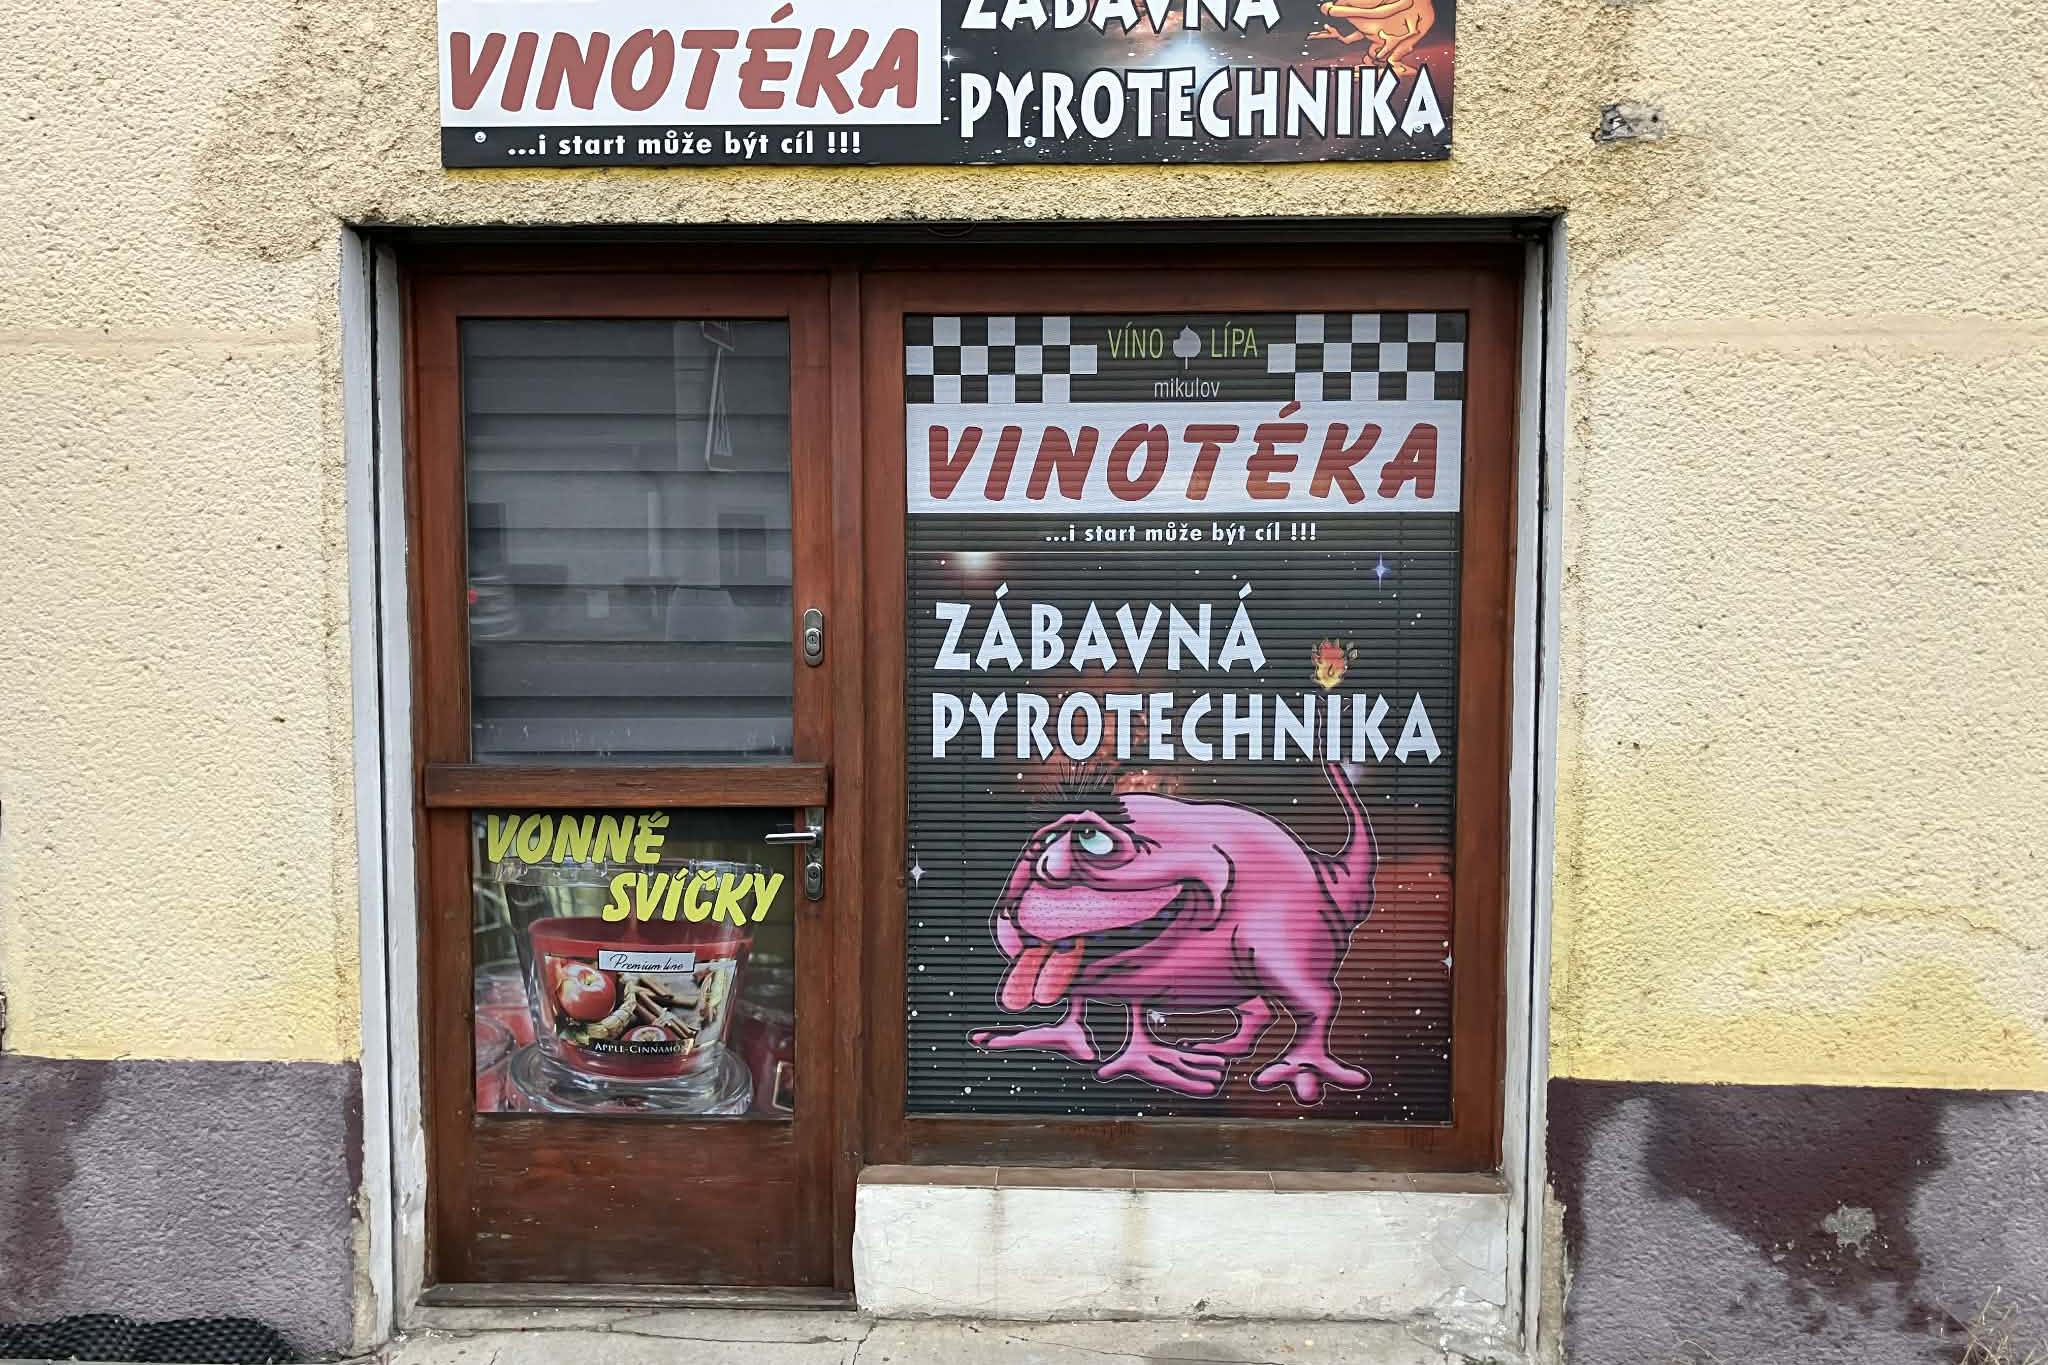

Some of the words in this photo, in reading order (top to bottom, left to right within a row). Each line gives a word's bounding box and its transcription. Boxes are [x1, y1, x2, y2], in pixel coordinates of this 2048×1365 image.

[449, 2, 919, 114] VINOTÉKA
[960, 64, 1446, 139] PYROTECHNIKA
[508, 134, 546, 155] ...i
[558, 135, 625, 155] start
[638, 131, 712, 155] může
[725, 131, 768, 159] být
[781, 130, 814, 154] cíl
[827, 131, 861, 154] !!!
[1107, 321, 1164, 359] VÍNO
[1211, 321, 1258, 358] LÍPA
[1154, 377, 1221, 398] mikulov
[928, 400, 1438, 504] VINOTÉKA
[1045, 524, 1075, 542] ...i
[1084, 525, 1136, 542] start
[1145, 522, 1202, 542] může
[1212, 522, 1246, 545] být
[1255, 523, 1280, 541] cíl
[1290, 522, 1317, 541] !!!
[933, 582, 1266, 672] ZÁBAVNÁ
[932, 692, 1441, 764] PYROTECHNIKA
[487, 811, 670, 865] VONNÉ
[602, 867, 785, 927] SVÍČKY
[609, 953, 660, 970] Premium
